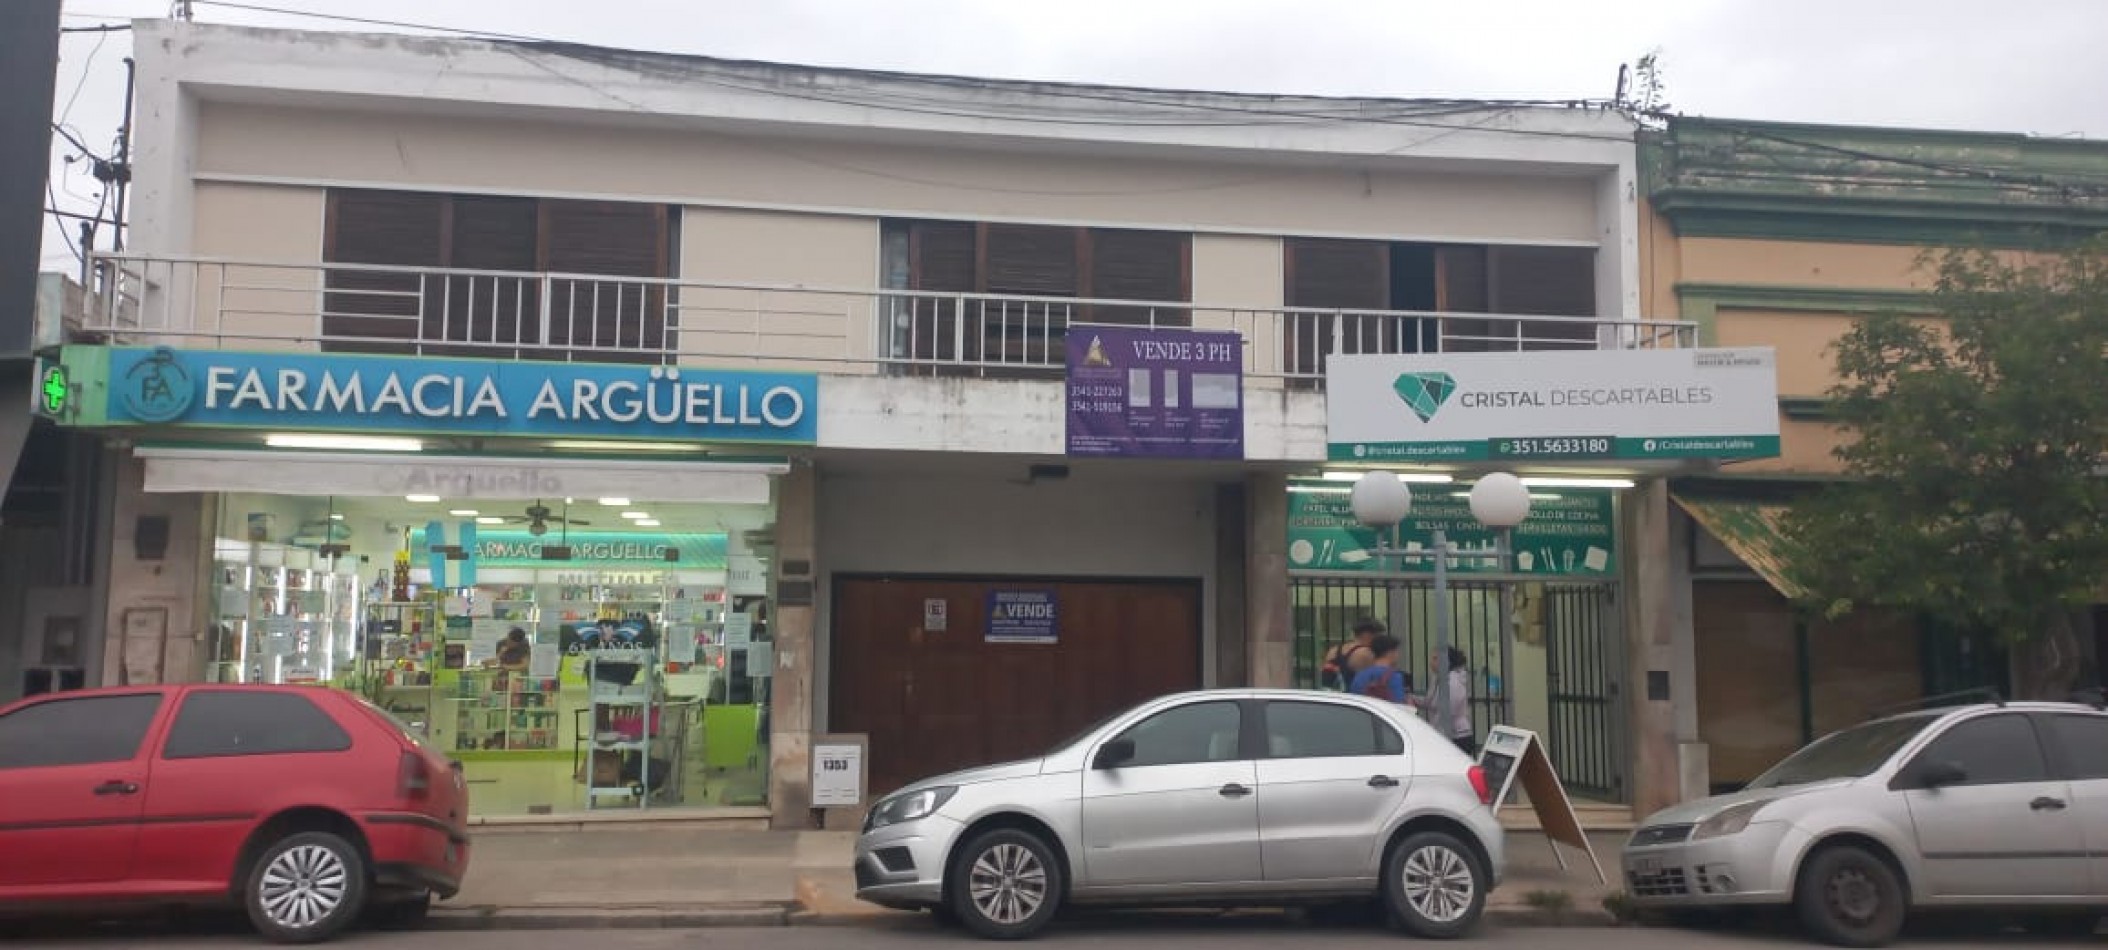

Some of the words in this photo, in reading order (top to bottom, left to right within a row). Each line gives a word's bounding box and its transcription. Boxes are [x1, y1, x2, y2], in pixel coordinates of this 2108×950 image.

[1133, 340, 1192, 361] VENDE
[1196, 342, 1205, 361] 3
[1209, 342, 1232, 362] PH
[205, 366, 508, 418] FARMACIA
[527, 366, 803, 427] ARGÜELLO
[1460, 391, 1546, 408] CRISTAL
[1551, 387, 1713, 406] DESCARTABLES
[1511, 438, 1608, 454] 351.5633180
[1006, 603, 1054, 619] VENDE
